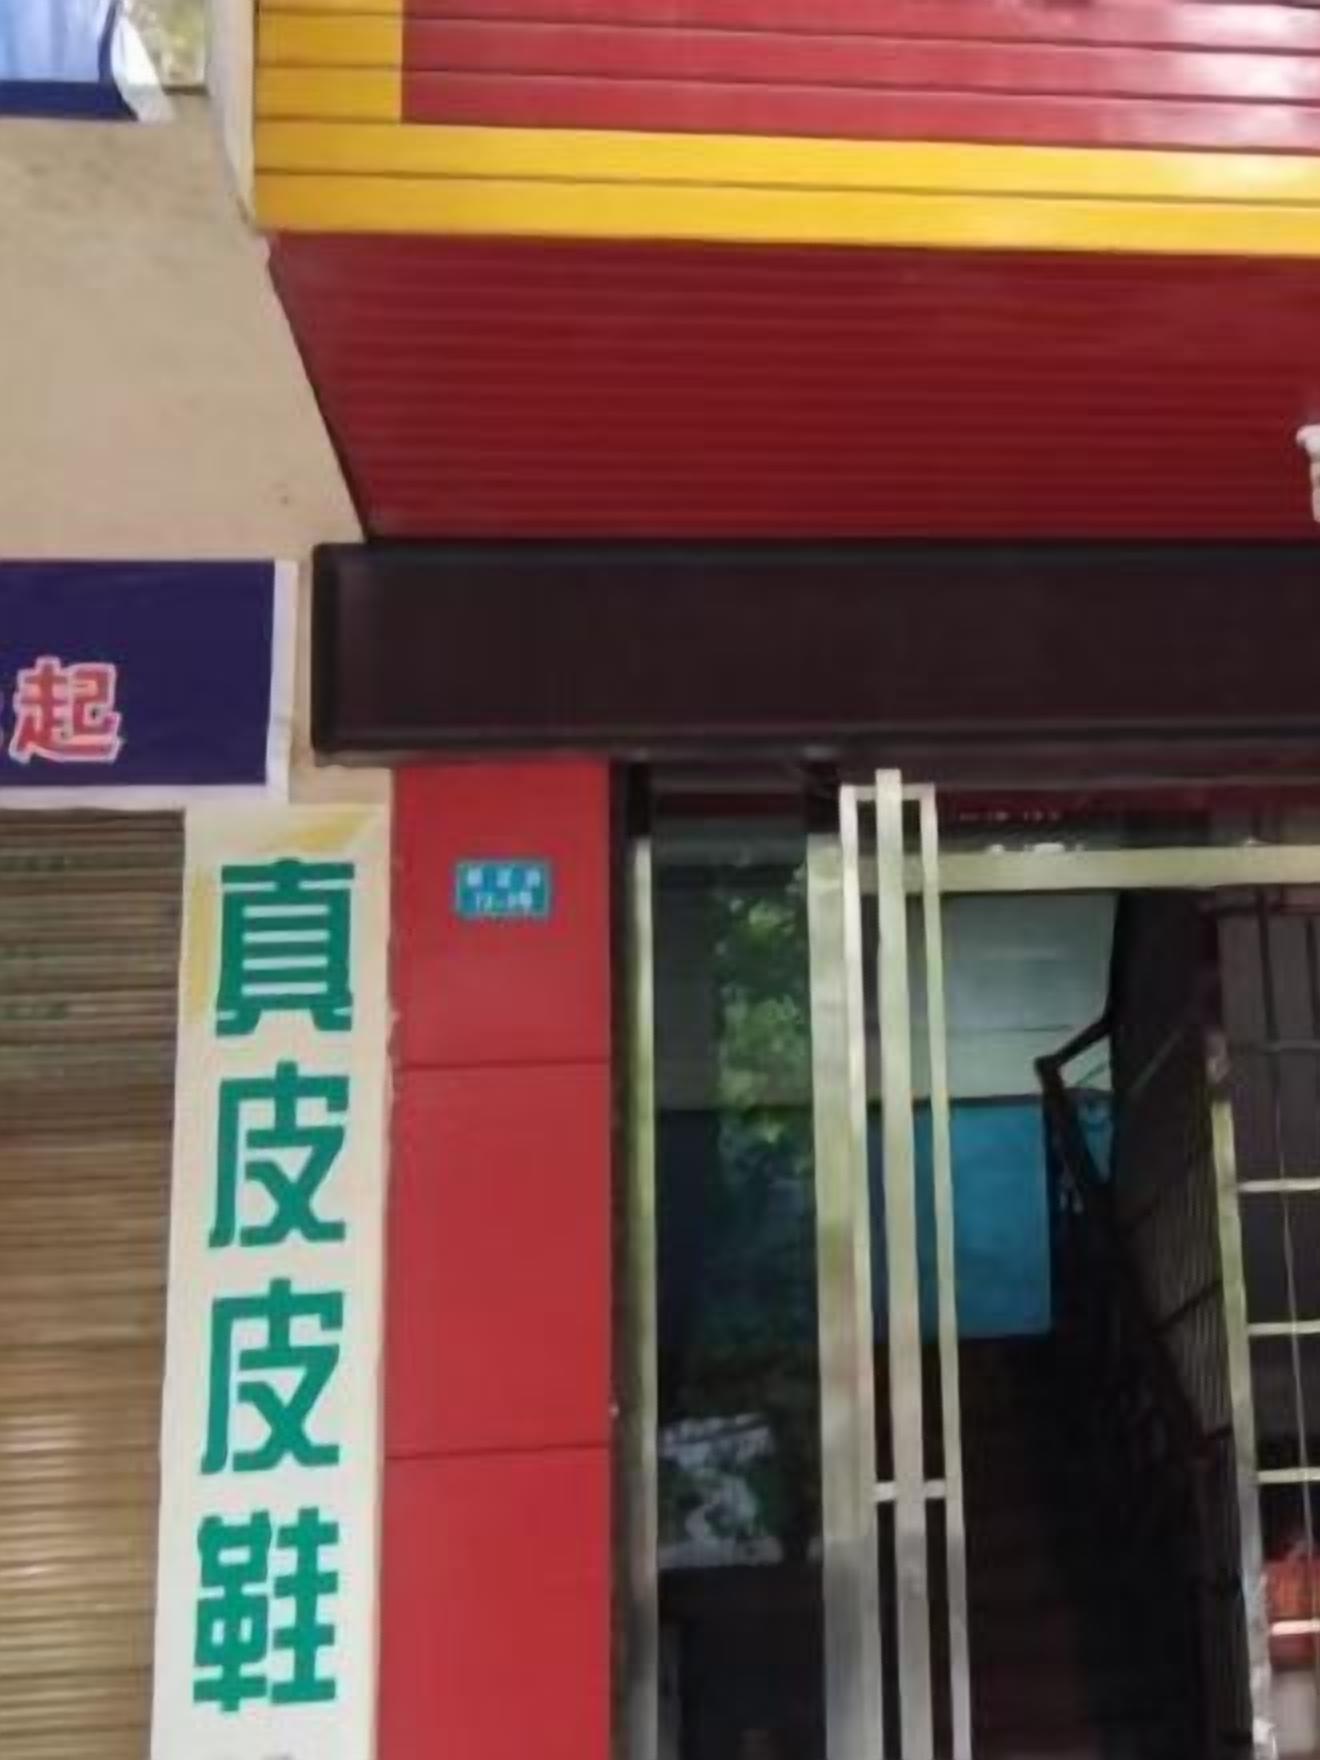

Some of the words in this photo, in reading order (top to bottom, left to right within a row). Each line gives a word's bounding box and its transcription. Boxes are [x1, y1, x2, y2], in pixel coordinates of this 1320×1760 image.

[8, 655, 123, 764] 起
[193, 855, 355, 1713] 真皮皮鞋
